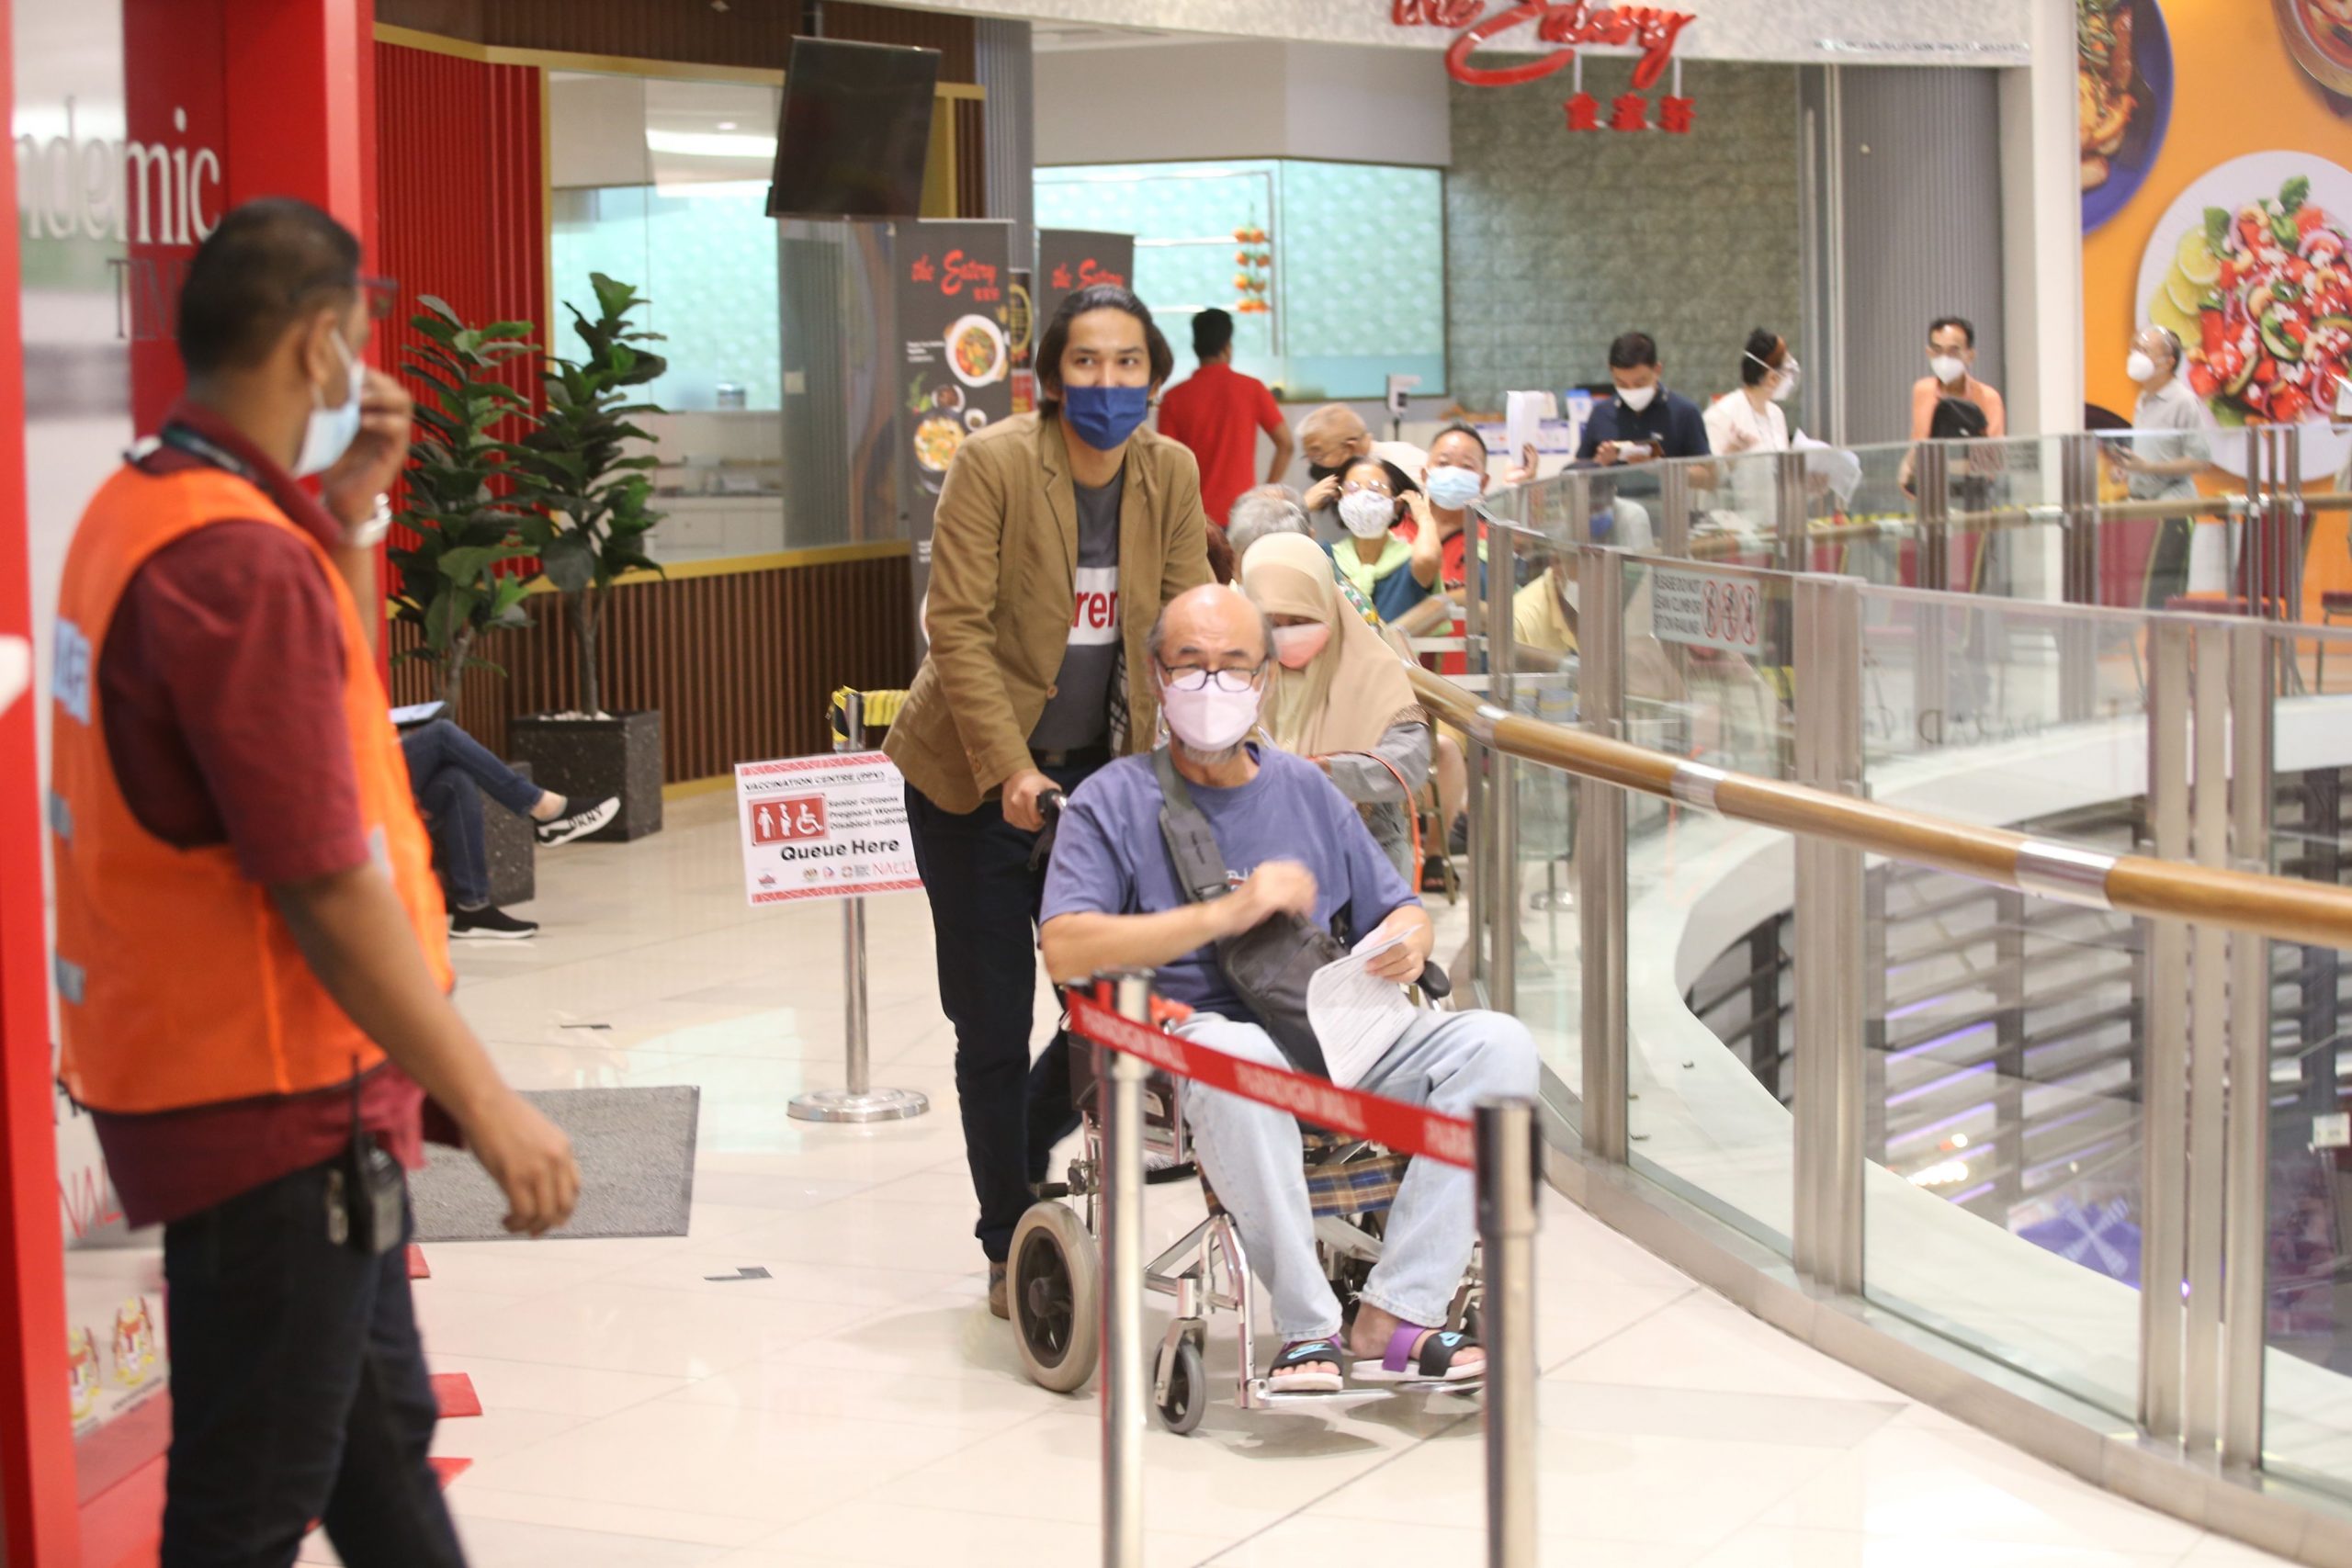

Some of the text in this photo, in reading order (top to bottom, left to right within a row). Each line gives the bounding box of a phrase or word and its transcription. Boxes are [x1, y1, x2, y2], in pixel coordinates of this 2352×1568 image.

[814, 773, 854, 787] CENTRE
[860, 795, 899, 807] Citizens
[829, 809, 872, 820] Pregnant
[830, 818, 871, 830] Disabled
[780, 838, 900, 861] Queue Here
